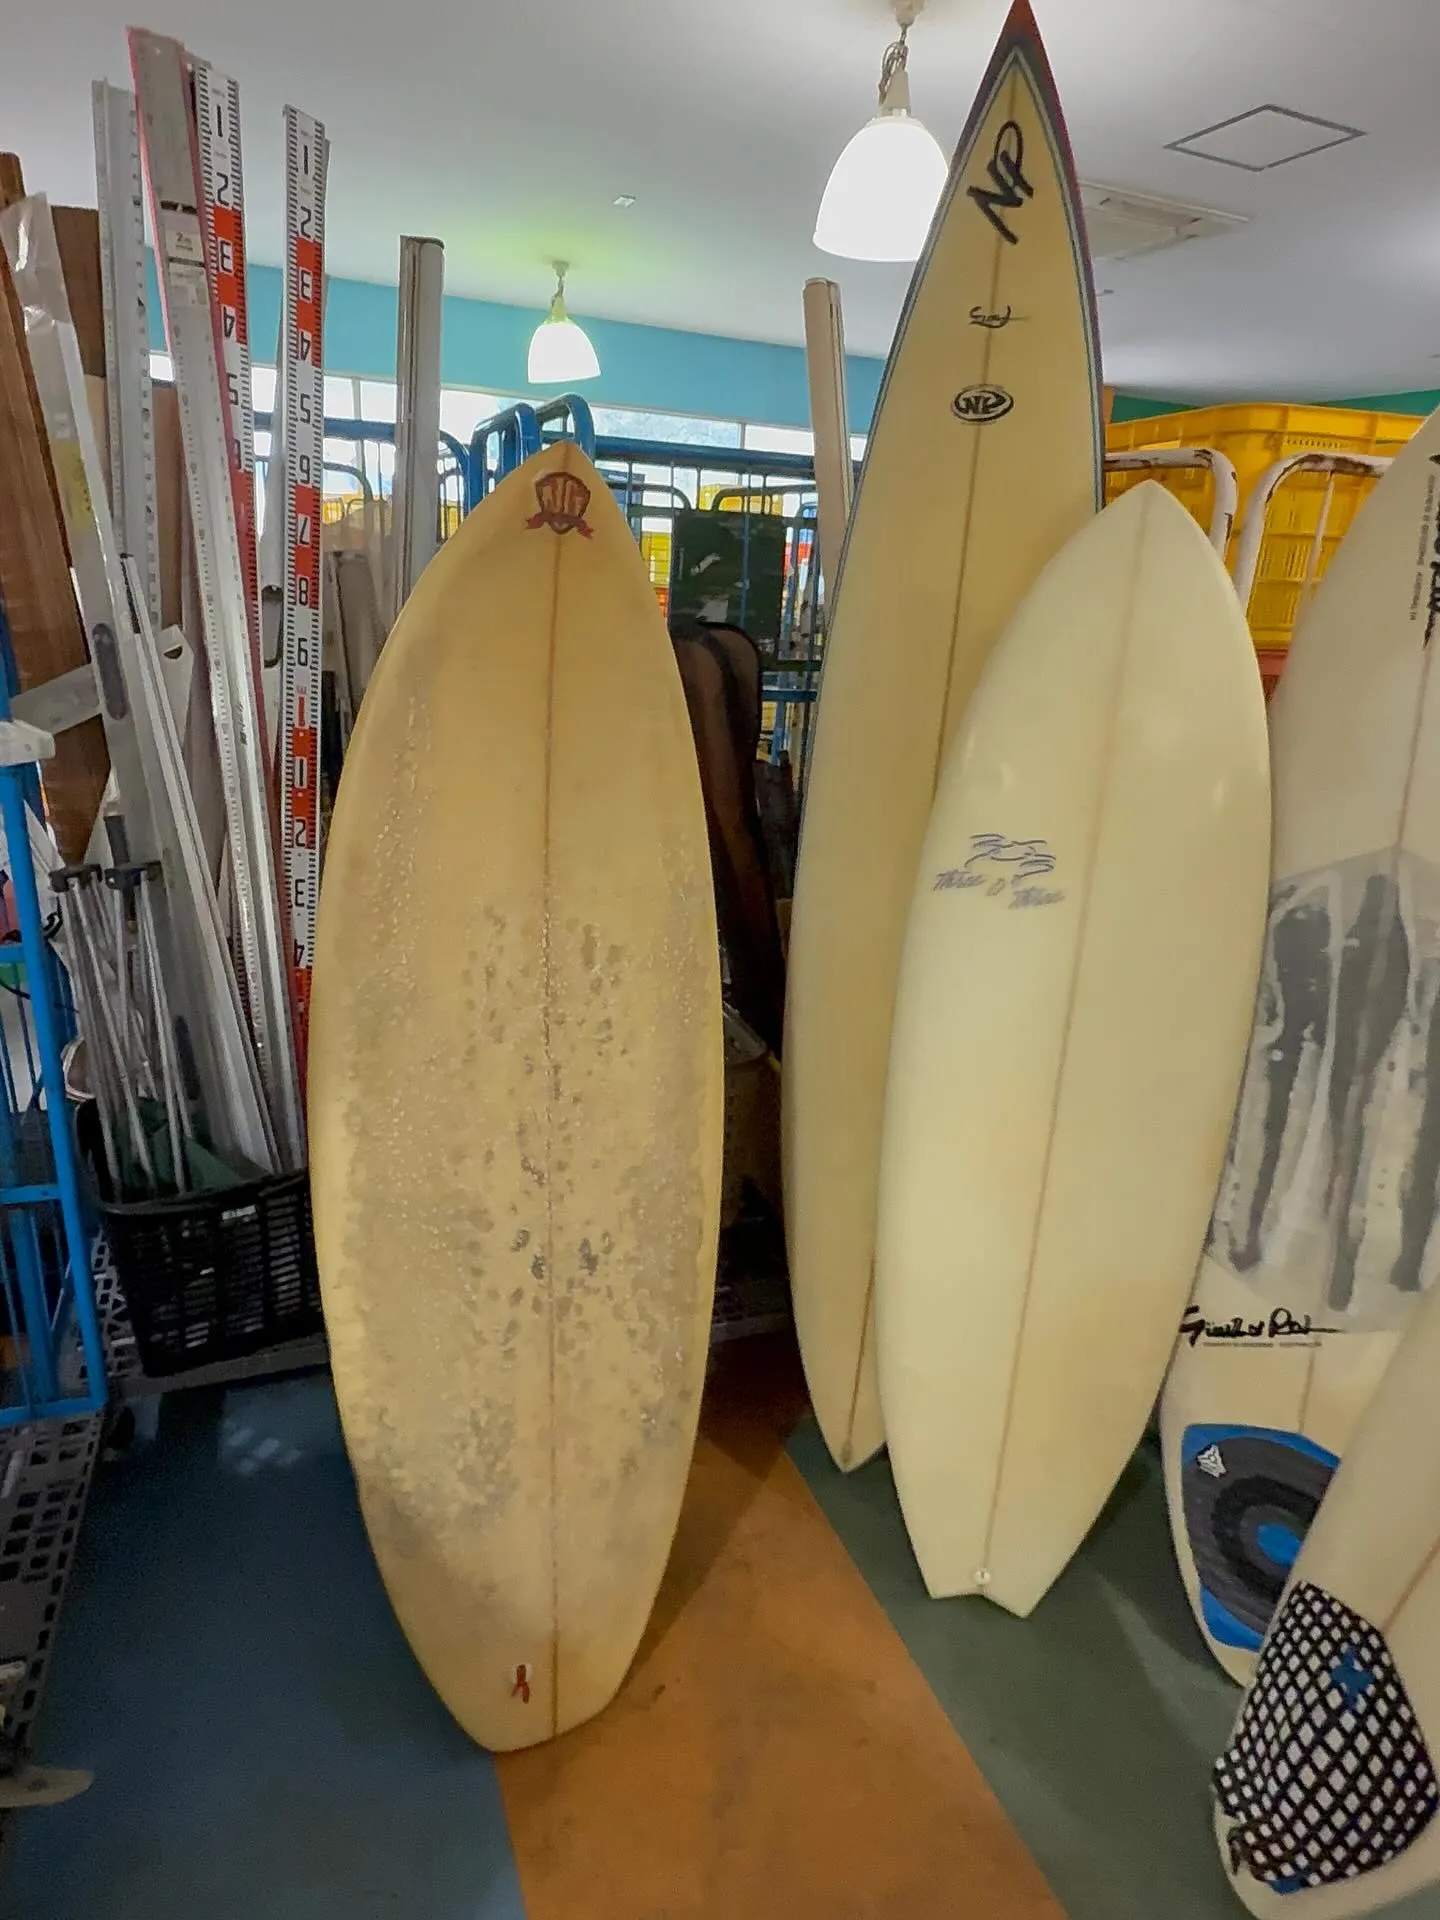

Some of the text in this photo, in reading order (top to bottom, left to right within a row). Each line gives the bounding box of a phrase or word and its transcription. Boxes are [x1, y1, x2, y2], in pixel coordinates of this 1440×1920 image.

[217, 105, 223, 137] 1
[303, 145, 309, 175] 1
[217, 173, 228, 206] 2
[300, 206, 312, 238] 2
[220, 240, 232, 273] 3
[301, 270, 312, 299] 3
[223, 306, 236, 338] 4
[300, 331, 312, 361] 4
[300, 393, 311, 424] 5
[300, 455, 311, 484] 6
[300, 517, 309, 545] 7
[298, 577, 309, 606] 8
[298, 638, 308, 666] 9
[298, 696, 305, 727] 1
[295, 819, 307, 847] 2
[295, 879, 305, 907] 3
[294, 939, 305, 966] 4
